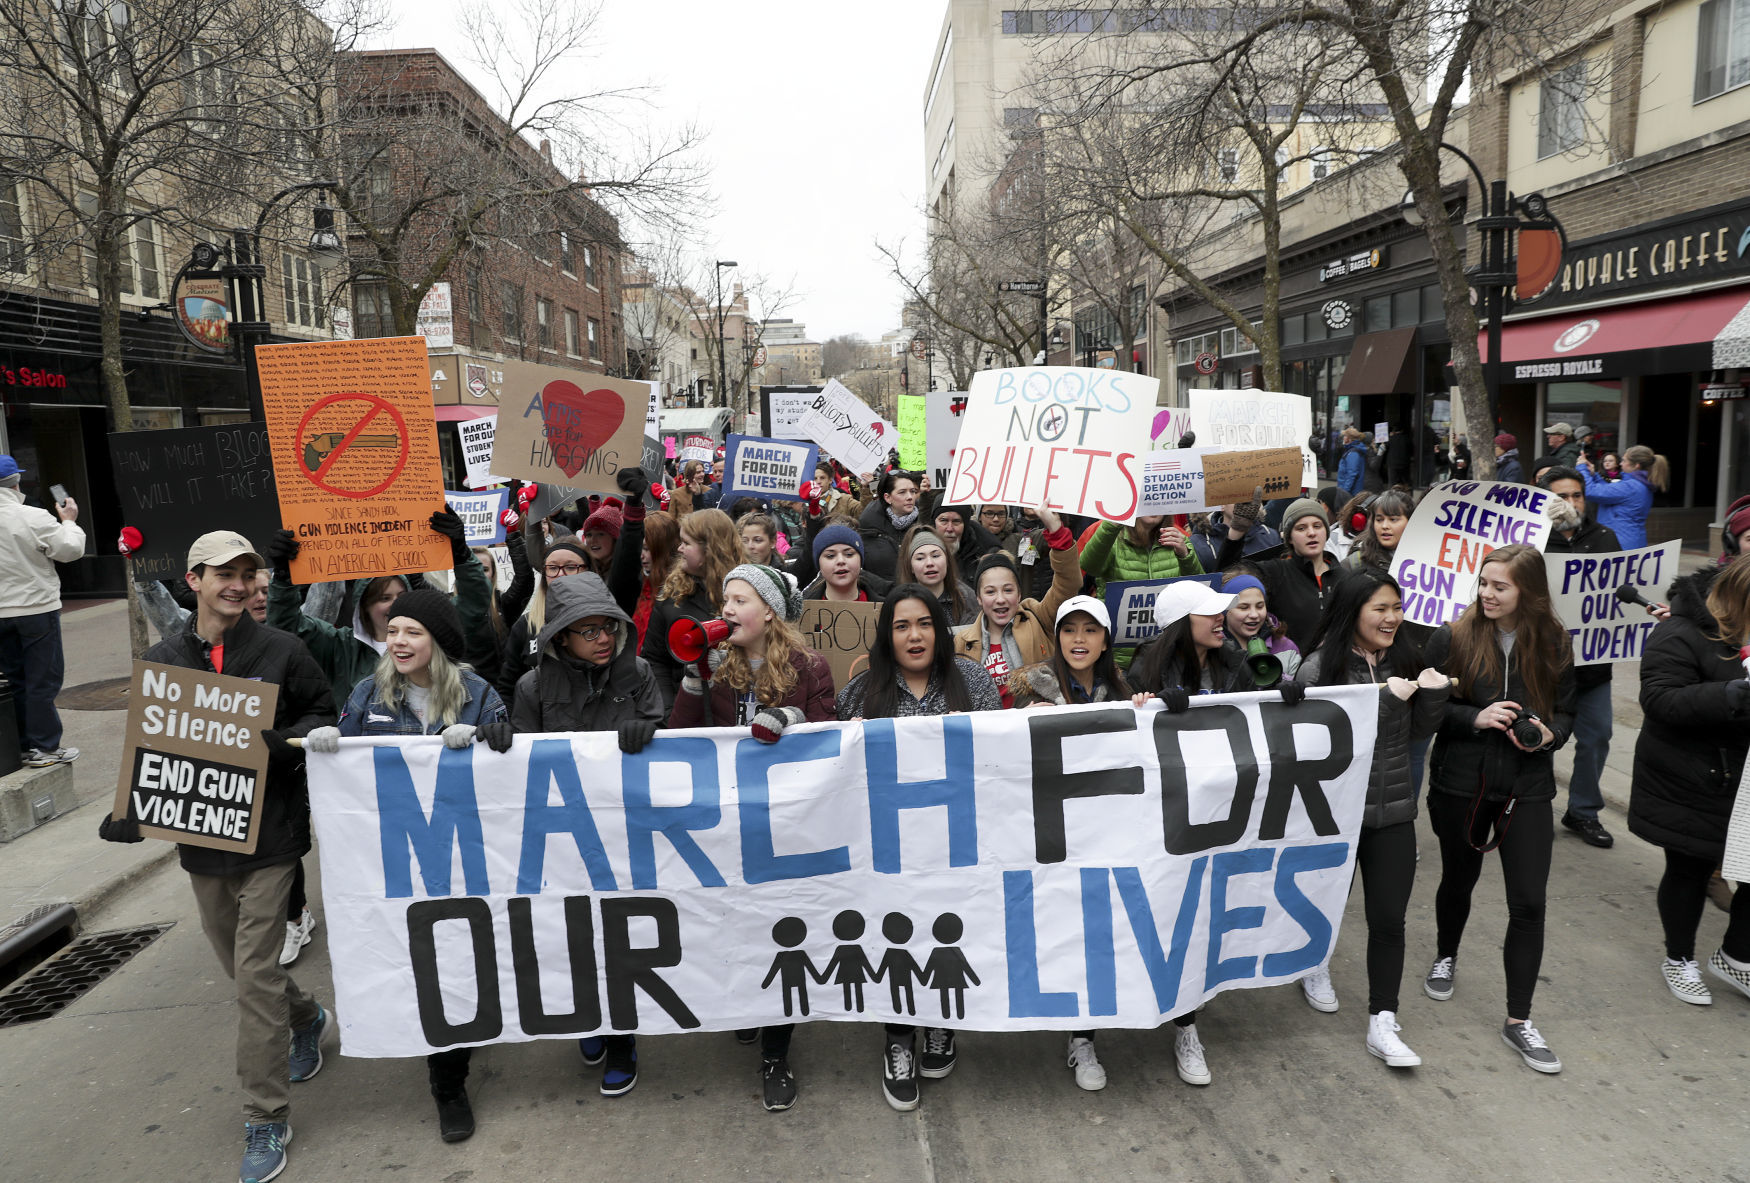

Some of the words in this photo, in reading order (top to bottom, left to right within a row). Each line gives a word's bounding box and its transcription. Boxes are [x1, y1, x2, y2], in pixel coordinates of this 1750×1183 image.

[1326, 265, 1346, 279] COFFEE
[1350, 257, 1371, 272] BAGELS
[1561, 247, 1639, 292] ROYALE
[1650, 227, 1729, 276] CAFFE
[19, 367, 67, 388] Salon
[1515, 363, 1561, 379] ESPRESSO
[1563, 359, 1603, 375] ROYALE
[994, 371, 1131, 413] BOOKS
[523, 391, 582, 426] Arms
[1006, 402, 1101, 446] NOT
[463, 421, 493, 435] MARCH
[464, 433, 480, 443] FOR
[542, 423, 562, 439] are
[117, 450, 151, 472] HOW
[164, 443, 207, 471] MUCH
[216, 430, 272, 469] BLOO
[468, 453, 491, 466] LIVES
[530, 440, 619, 476] HUGGING
[742, 446, 792, 463] MARCH
[740, 473, 778, 489] LIVES
[741, 460, 768, 475] FOR
[769, 464, 798, 478] OUR
[949, 445, 1138, 521] BULLETS
[1143, 471, 1204, 484] STUDENTS
[133, 481, 173, 510] WILL
[187, 476, 204, 504] IT
[1144, 481, 1193, 493] DEMAND
[1144, 491, 1186, 502] ACTION
[1441, 482, 1480, 496] NO
[1485, 484, 1547, 515] MORE
[299, 524, 322, 537] GUN
[325, 521, 368, 536] VIOLENCE
[370, 519, 414, 534] INCIDENT
[325, 507, 353, 520] SINCE
[356, 507, 379, 518] SANDY
[1434, 500, 1542, 547] SILENCE
[335, 539, 349, 550] ON
[351, 537, 369, 548] ALL
[370, 537, 384, 547] OF
[387, 535, 415, 547] THESE
[418, 534, 445, 544] DATES
[135, 553, 176, 575] March
[309, 556, 323, 575] IN
[327, 552, 386, 574] AMERICAN
[391, 550, 428, 569] SCHOOLS
[1561, 549, 1664, 595] PROTECT
[1398, 559, 1456, 599] GUN
[1401, 588, 1467, 625] VIOLE
[1581, 592, 1625, 624] OUR
[1125, 625, 1161, 639] LIV
[1567, 622, 1656, 661] TUDENT
[142, 669, 181, 702] No
[194, 683, 262, 717] More
[142, 705, 250, 750] Silence
[138, 753, 195, 794] END
[198, 767, 255, 805] GUN
[373, 714, 980, 898] MARCH
[1028, 699, 1354, 864] FOR
[132, 790, 249, 840] VIOLENCE
[406, 895, 702, 1047] OUR
[1003, 841, 1351, 1018] LIVES
